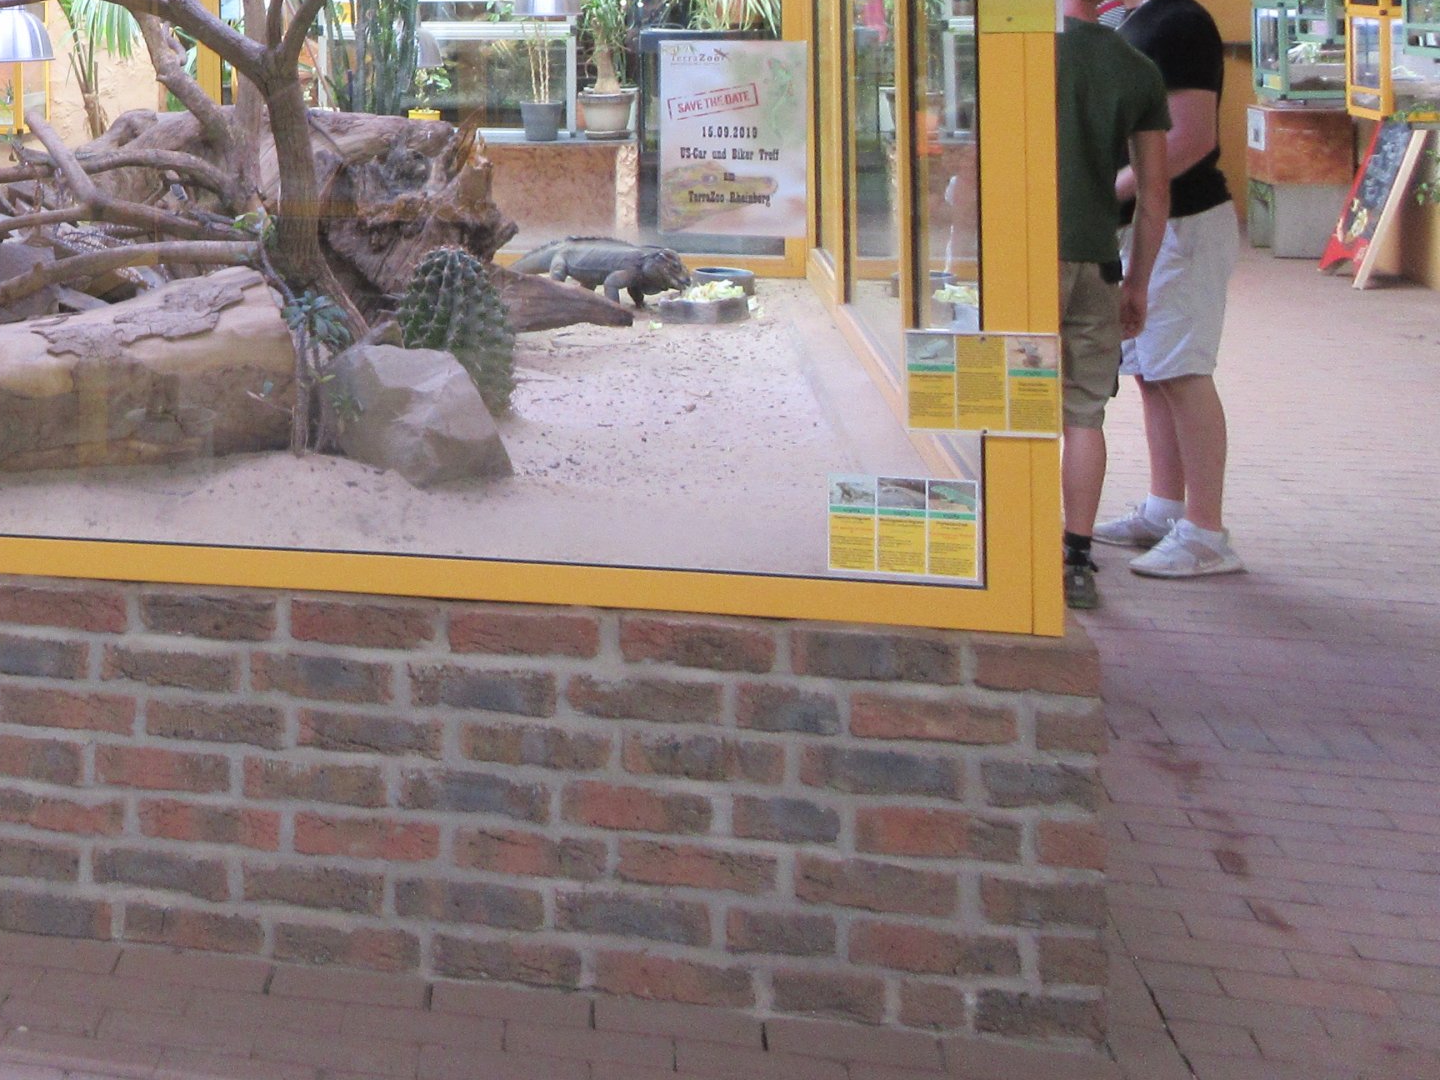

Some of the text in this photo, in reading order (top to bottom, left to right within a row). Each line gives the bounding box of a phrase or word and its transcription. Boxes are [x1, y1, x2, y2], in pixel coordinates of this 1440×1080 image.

[677, 90, 750, 113] SAVE THE DATE
[680, 146, 780, 161] US-Car und Biker Treff
[688, 190, 771, 207] TerraZoo Rheinberg
